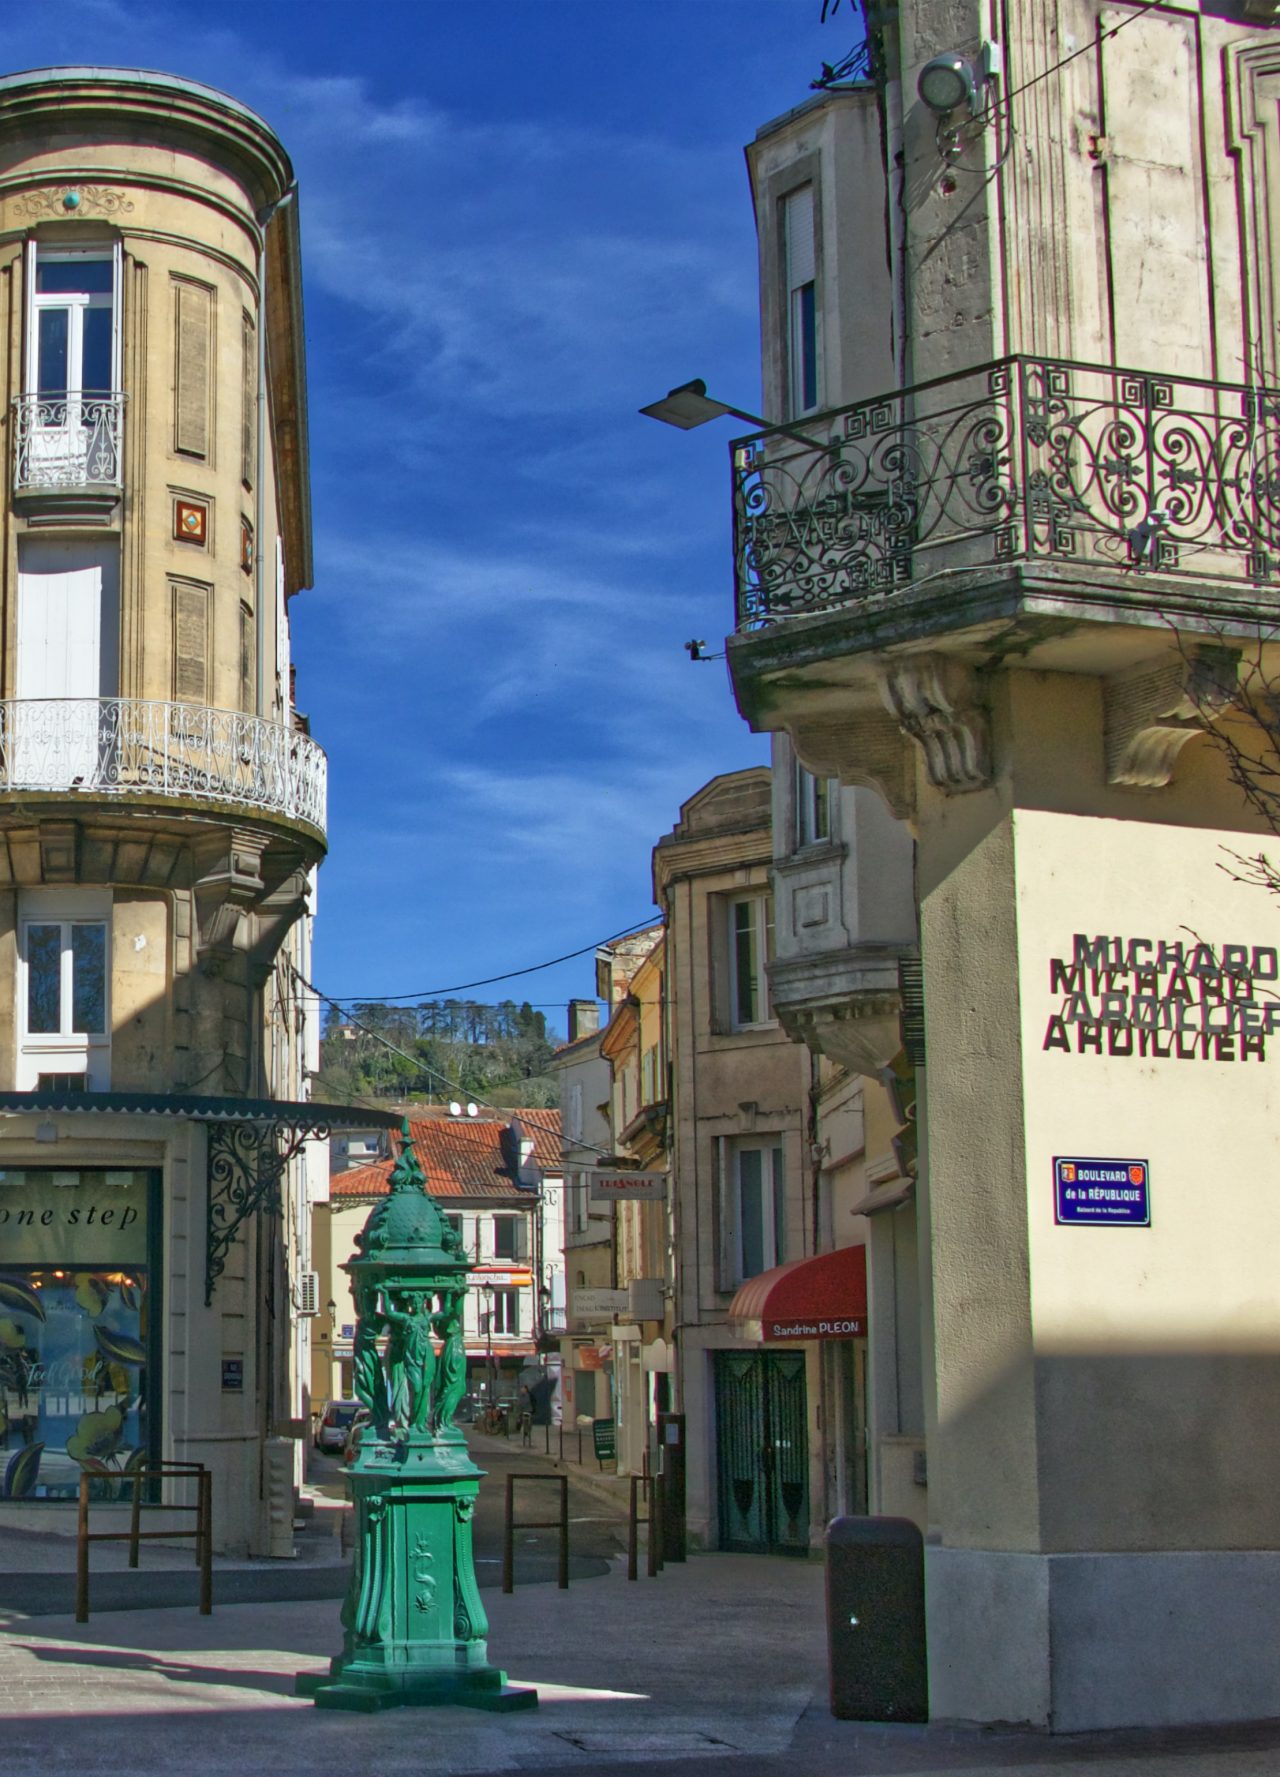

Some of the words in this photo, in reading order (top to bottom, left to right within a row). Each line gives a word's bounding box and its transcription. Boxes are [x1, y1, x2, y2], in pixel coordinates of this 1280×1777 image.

[1073, 934, 1278, 981] MICHARD
[1077, 1169, 1127, 1182] BOULEVARD
[1065, 1188, 1076, 1200] de
[1078, 1188, 1086, 1200] la
[1088, 1186, 1141, 1201] RÉPUBLIQUE
[68, 1205, 138, 1231] step
[773, 1324, 817, 1336] Sandrine
[819, 1321, 859, 1333] PLEON
